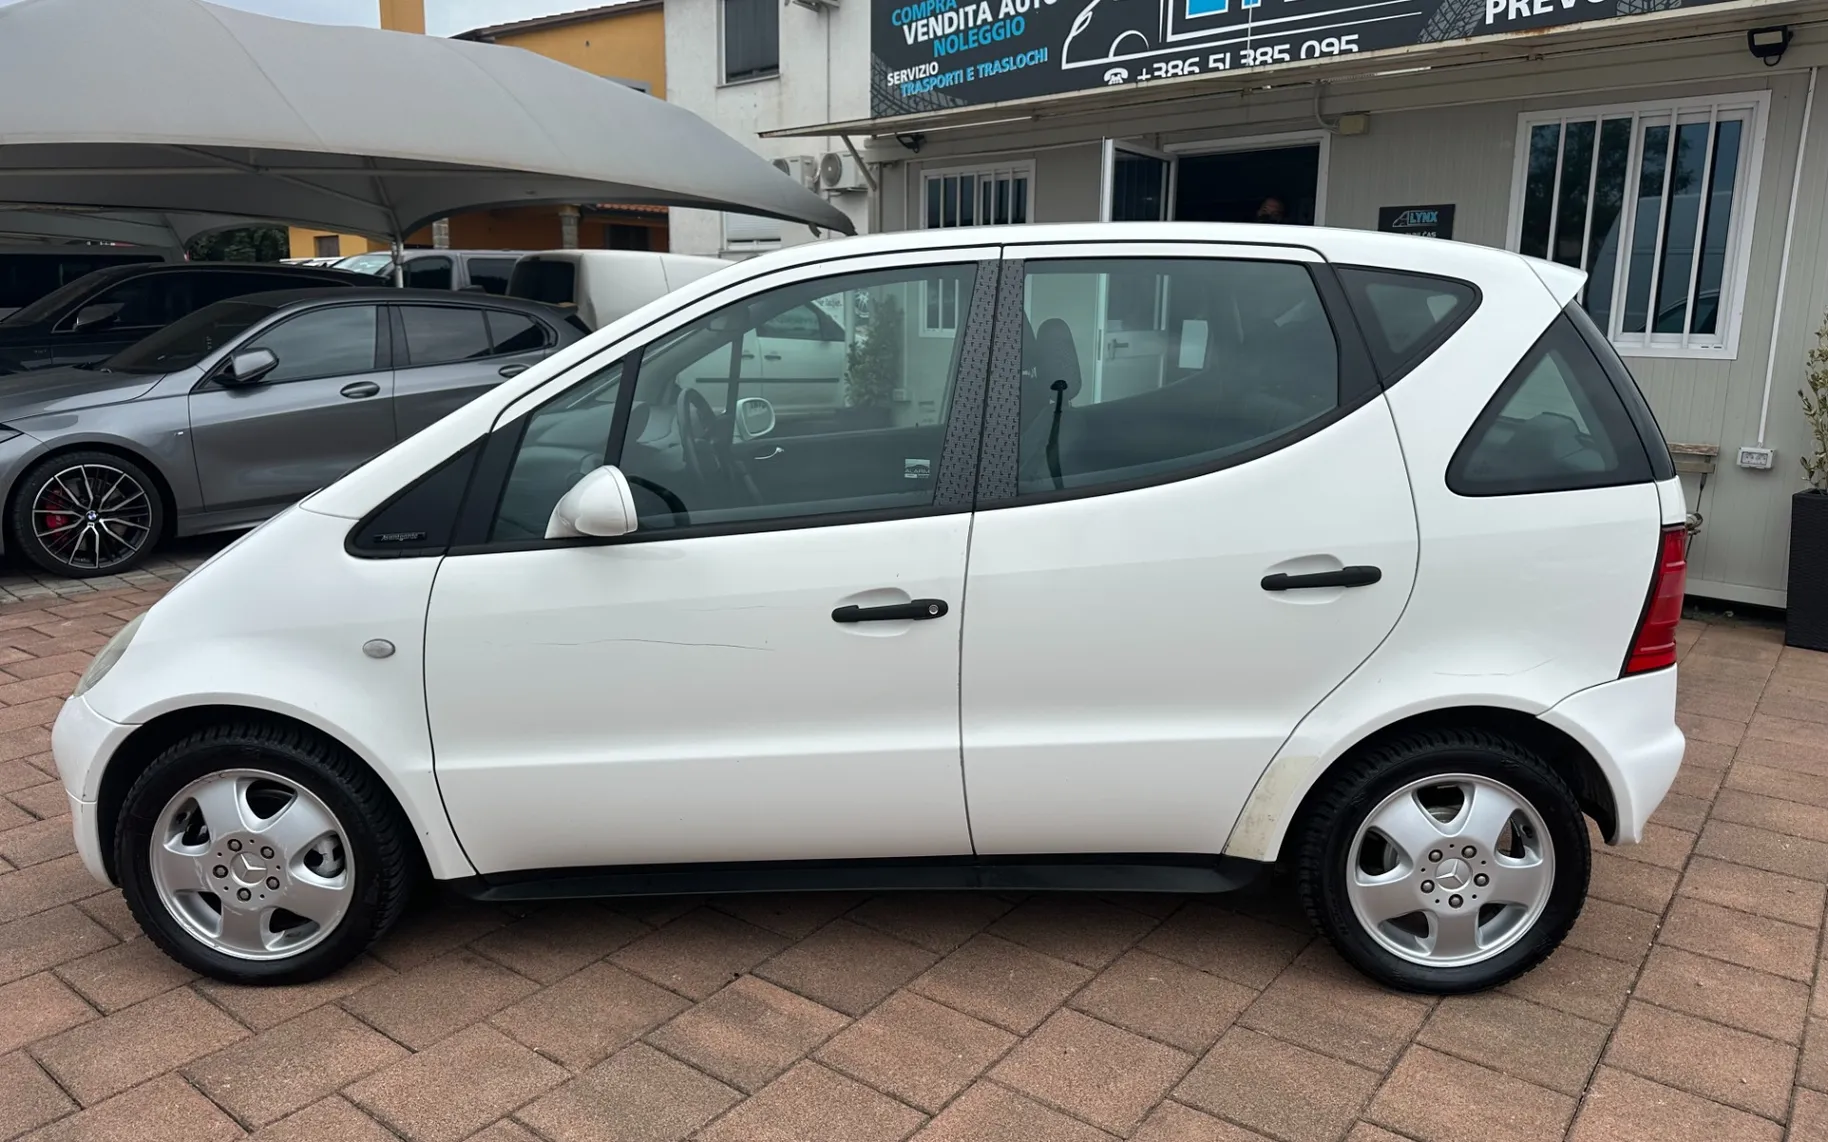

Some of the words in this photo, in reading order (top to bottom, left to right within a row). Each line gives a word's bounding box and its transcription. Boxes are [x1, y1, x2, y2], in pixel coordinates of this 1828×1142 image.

[892, 0, 957, 26] COMPRA
[903, 1, 993, 45] VENDITA
[933, 16, 1026, 57] NOLEGGIO
[887, 61, 939, 86] SERVIZIO
[900, 69, 963, 97] TRASPORTI
[966, 67, 975, 82] E
[977, 47, 1048, 79] TRASLOCHI
